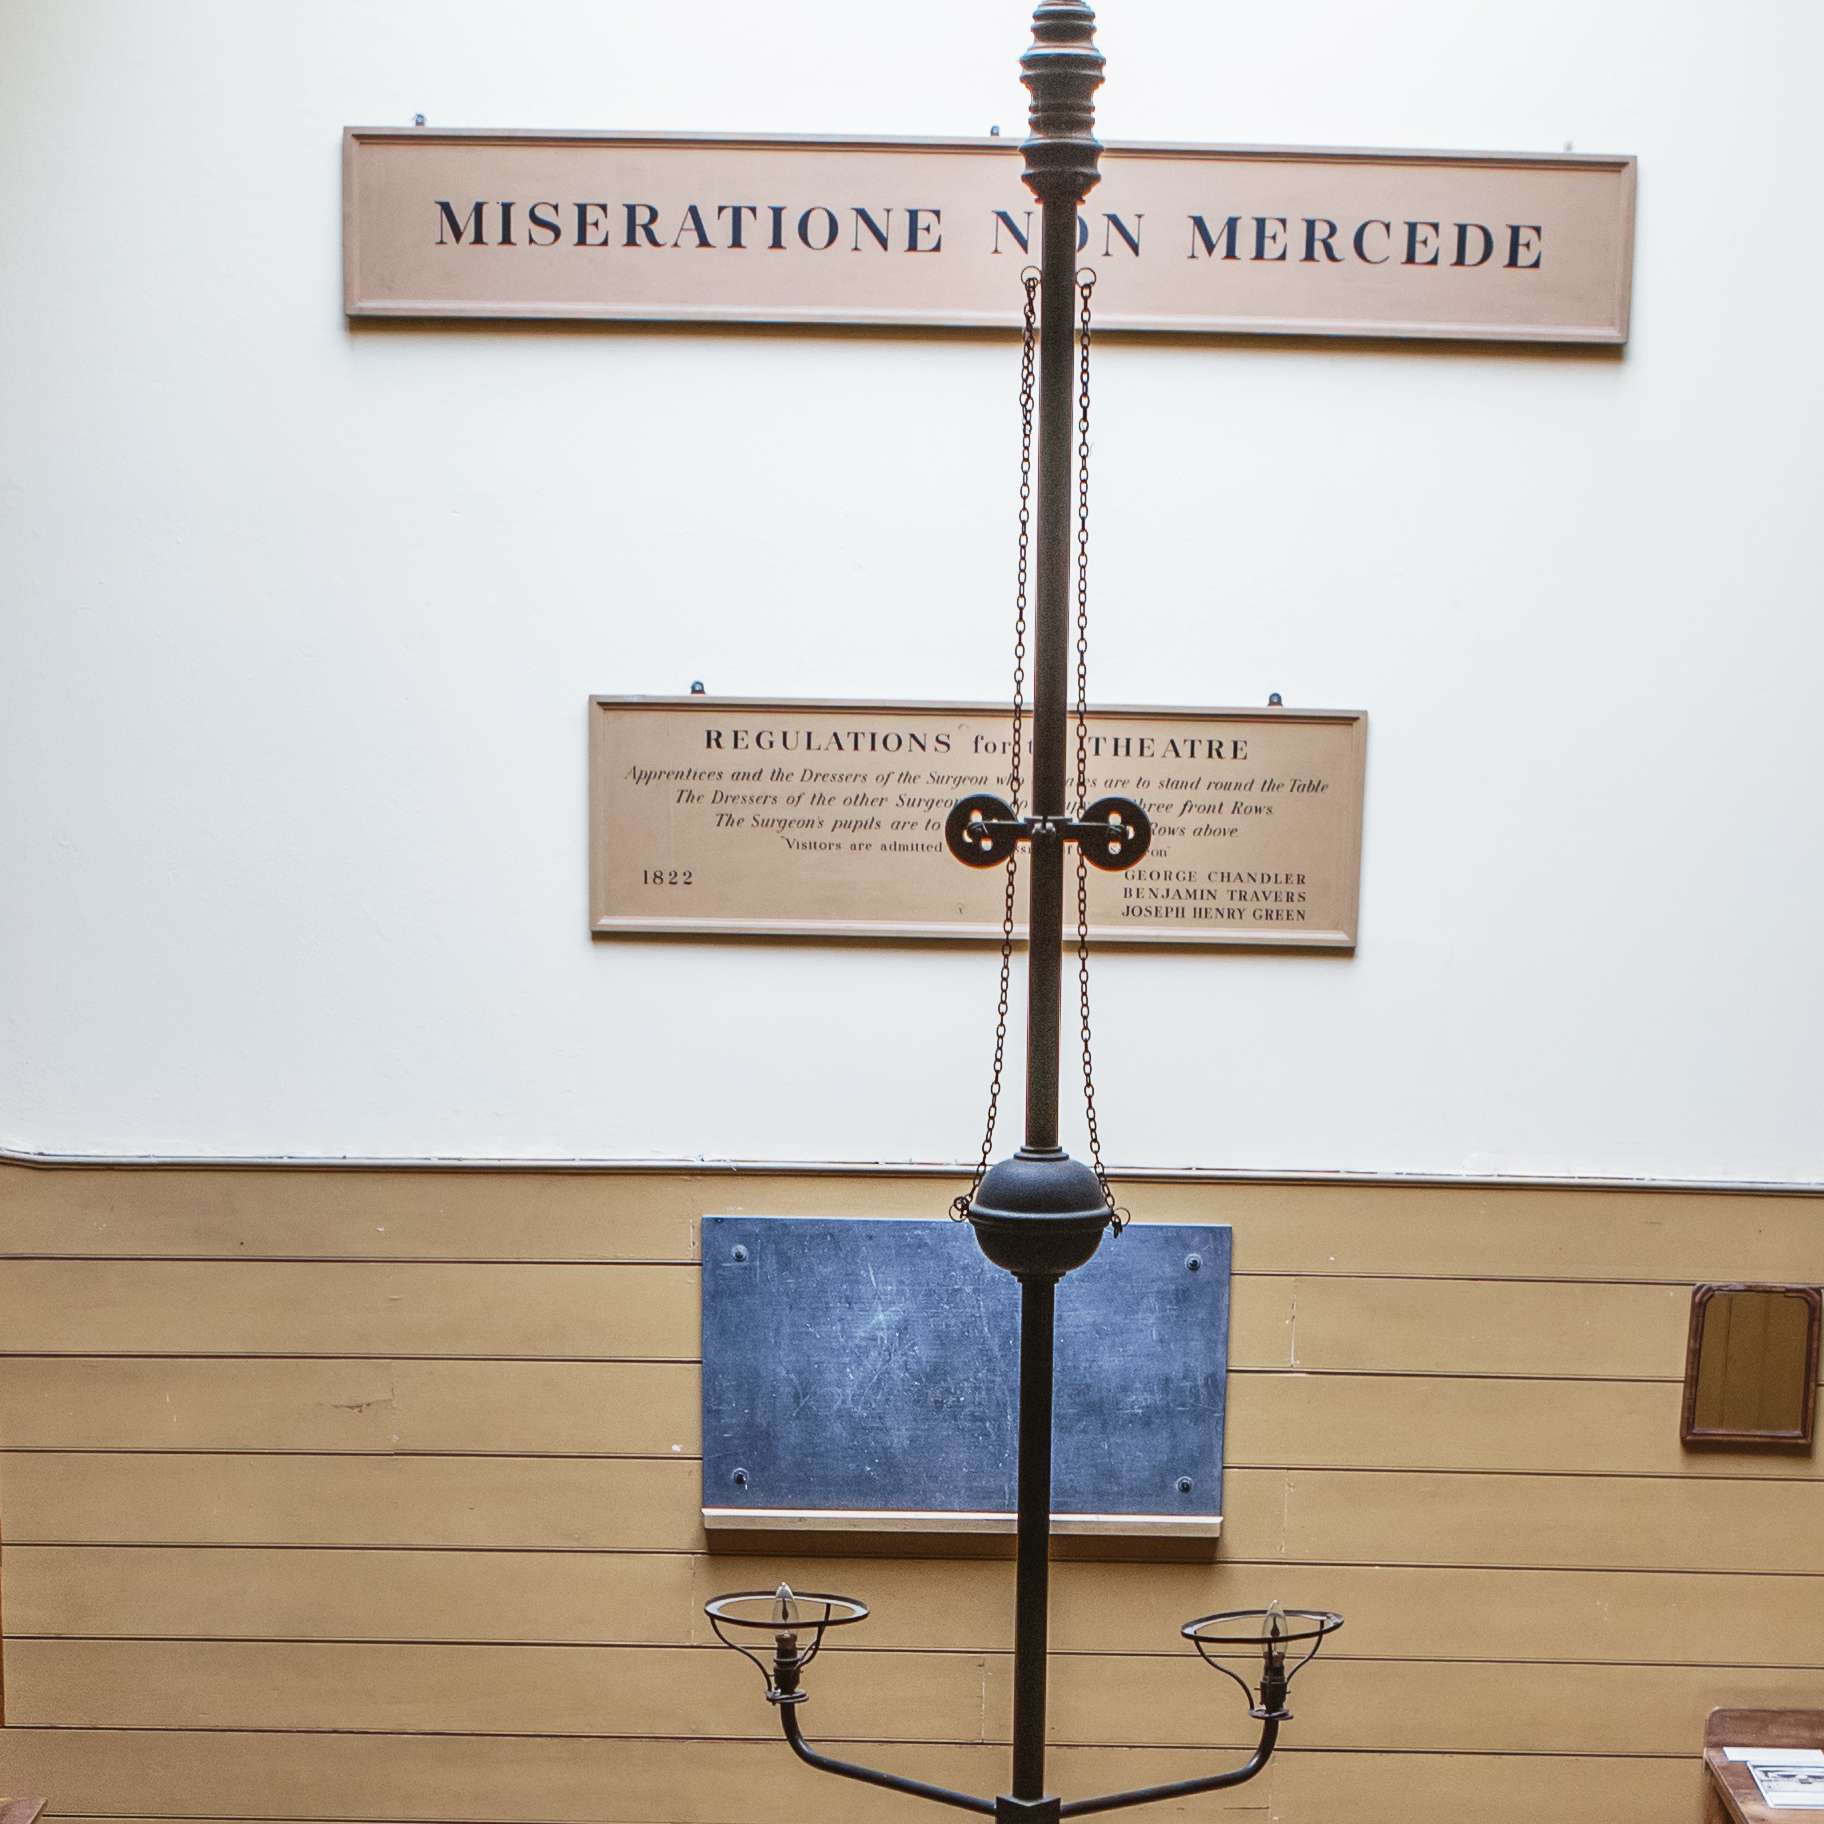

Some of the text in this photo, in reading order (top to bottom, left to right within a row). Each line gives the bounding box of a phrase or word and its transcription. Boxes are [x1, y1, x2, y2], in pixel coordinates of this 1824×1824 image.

[433, 199, 942, 254] MISERATIONE
[1186, 214, 1543, 270] MERCEDE
[704, 729, 951, 754] REGULATIONS
[973, 734, 1010, 755] for
[1088, 736, 1249, 760] THEATRE
[624, 764, 724, 786] Apprentices
[730, 767, 764, 783] and
[769, 767, 795, 783] the
[800, 768, 868, 784] Dressers
[875, 770, 895, 787] of
[896, 771, 921, 785] the
[925, 771, 988, 790] Surgeon
[1103, 776, 1131, 789] are
[1135, 776, 1151, 789] to
[1157, 777, 1202, 791] stand
[1206, 778, 1254, 793] round
[1260, 779, 1285, 793] the
[1288, 778, 1329, 794] Table
[676, 788, 705, 804] The
[711, 789, 778, 805] Dressers
[785, 792, 806, 808] of
[810, 792, 837, 807] the
[842, 792, 888, 808] other
[895, 794, 957, 813] Surgeo
[1138, 798, 1174, 813] hree
[1177, 799, 1224, 818] front
[1230, 800, 1274, 816] Rows
[715, 812, 745, 828] The
[750, 813, 825, 834] Surgeon's
[830, 815, 882, 833] pupils
[890, 819, 919, 832] are
[924, 818, 942, 832] to
[1191, 823, 1239, 839] above
[849, 839, 873, 851] are
[880, 839, 943, 853] admitted
[643, 869, 693, 886] 1822
[1124, 869, 1307, 886] GEORGE CHANDLER
[1123, 886, 1307, 903] BENJAMIN TRAVERS
[1121, 904, 1307, 922] JOSEPH HENRY GREEN
